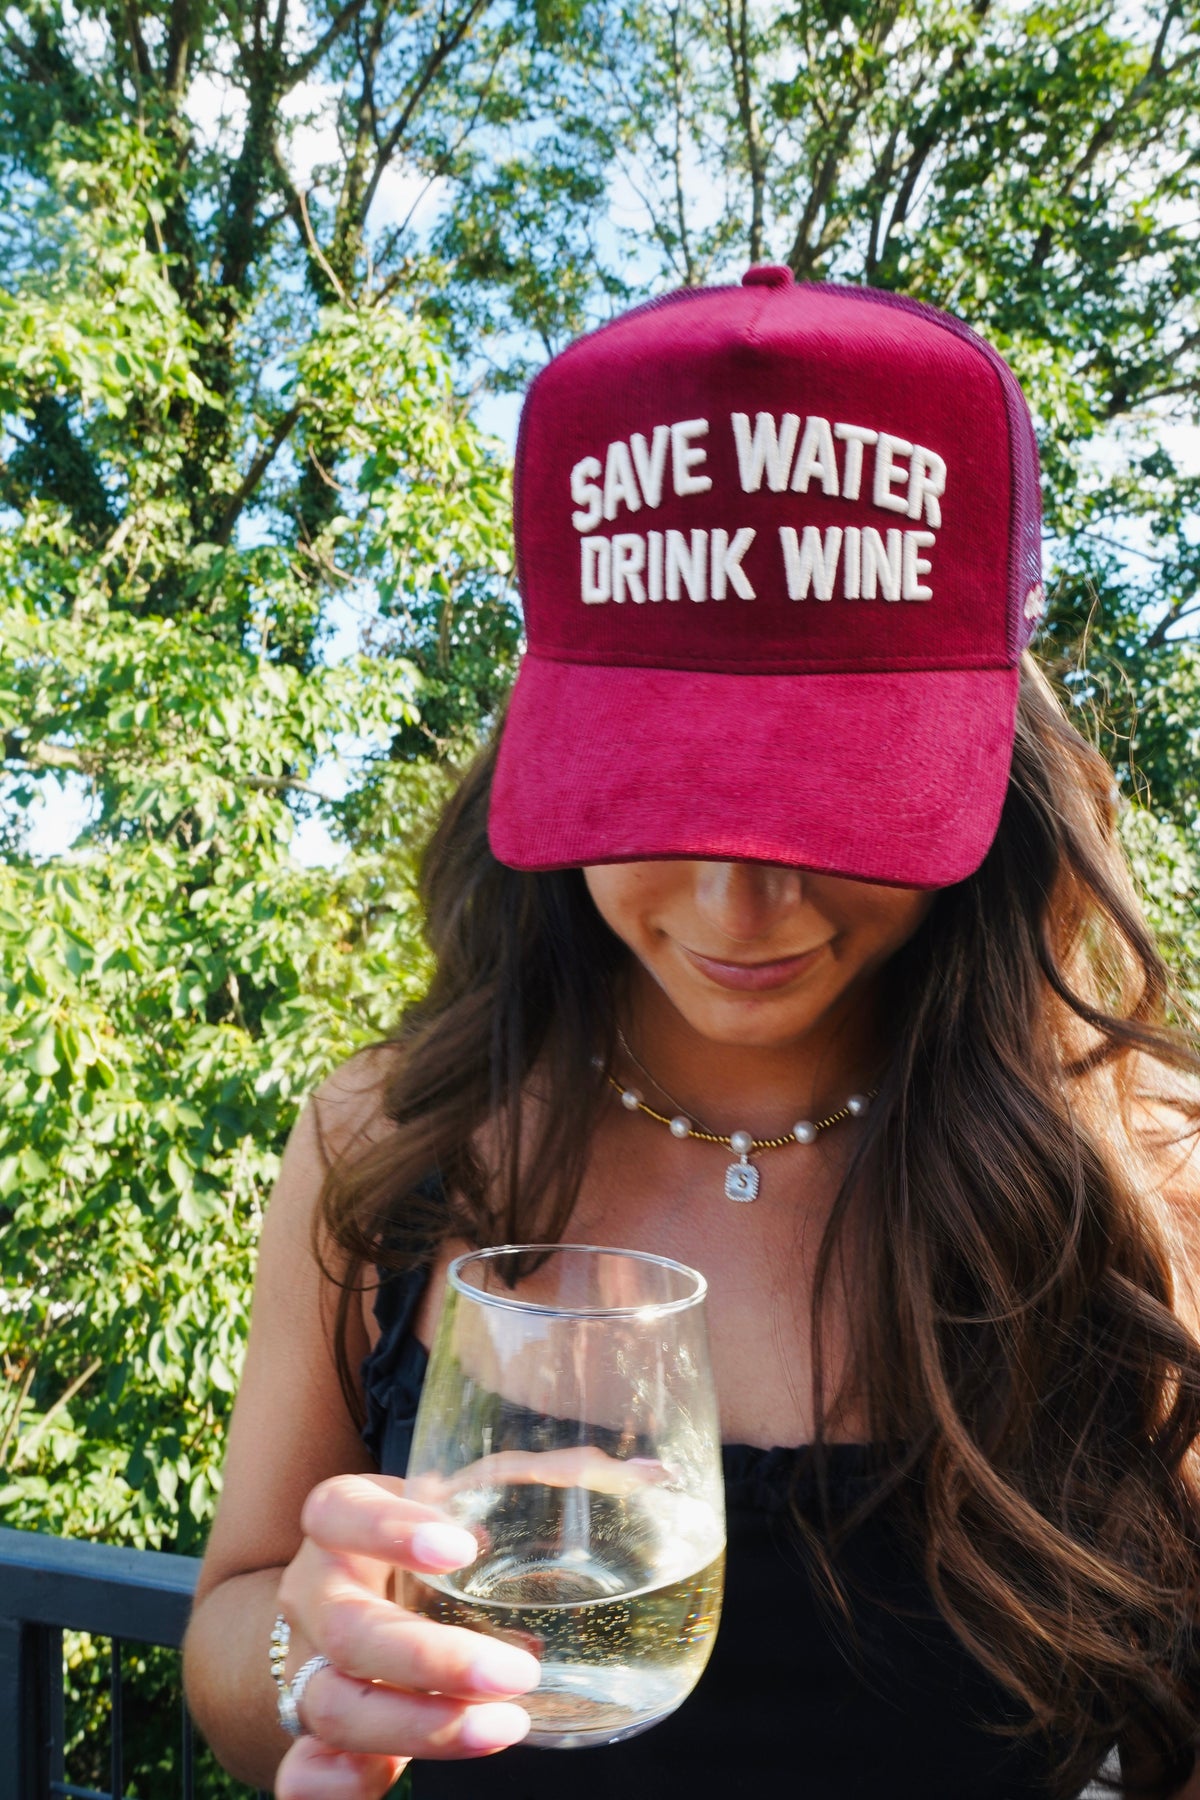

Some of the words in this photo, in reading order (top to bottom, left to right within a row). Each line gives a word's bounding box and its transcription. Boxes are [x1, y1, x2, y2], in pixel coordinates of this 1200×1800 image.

[570, 417, 713, 533] SAVE
[730, 411, 947, 529] WATER
[580, 526, 757, 604] DRINK
[778, 525, 936, 602] WINE
[738, 1172, 748, 1189] S
